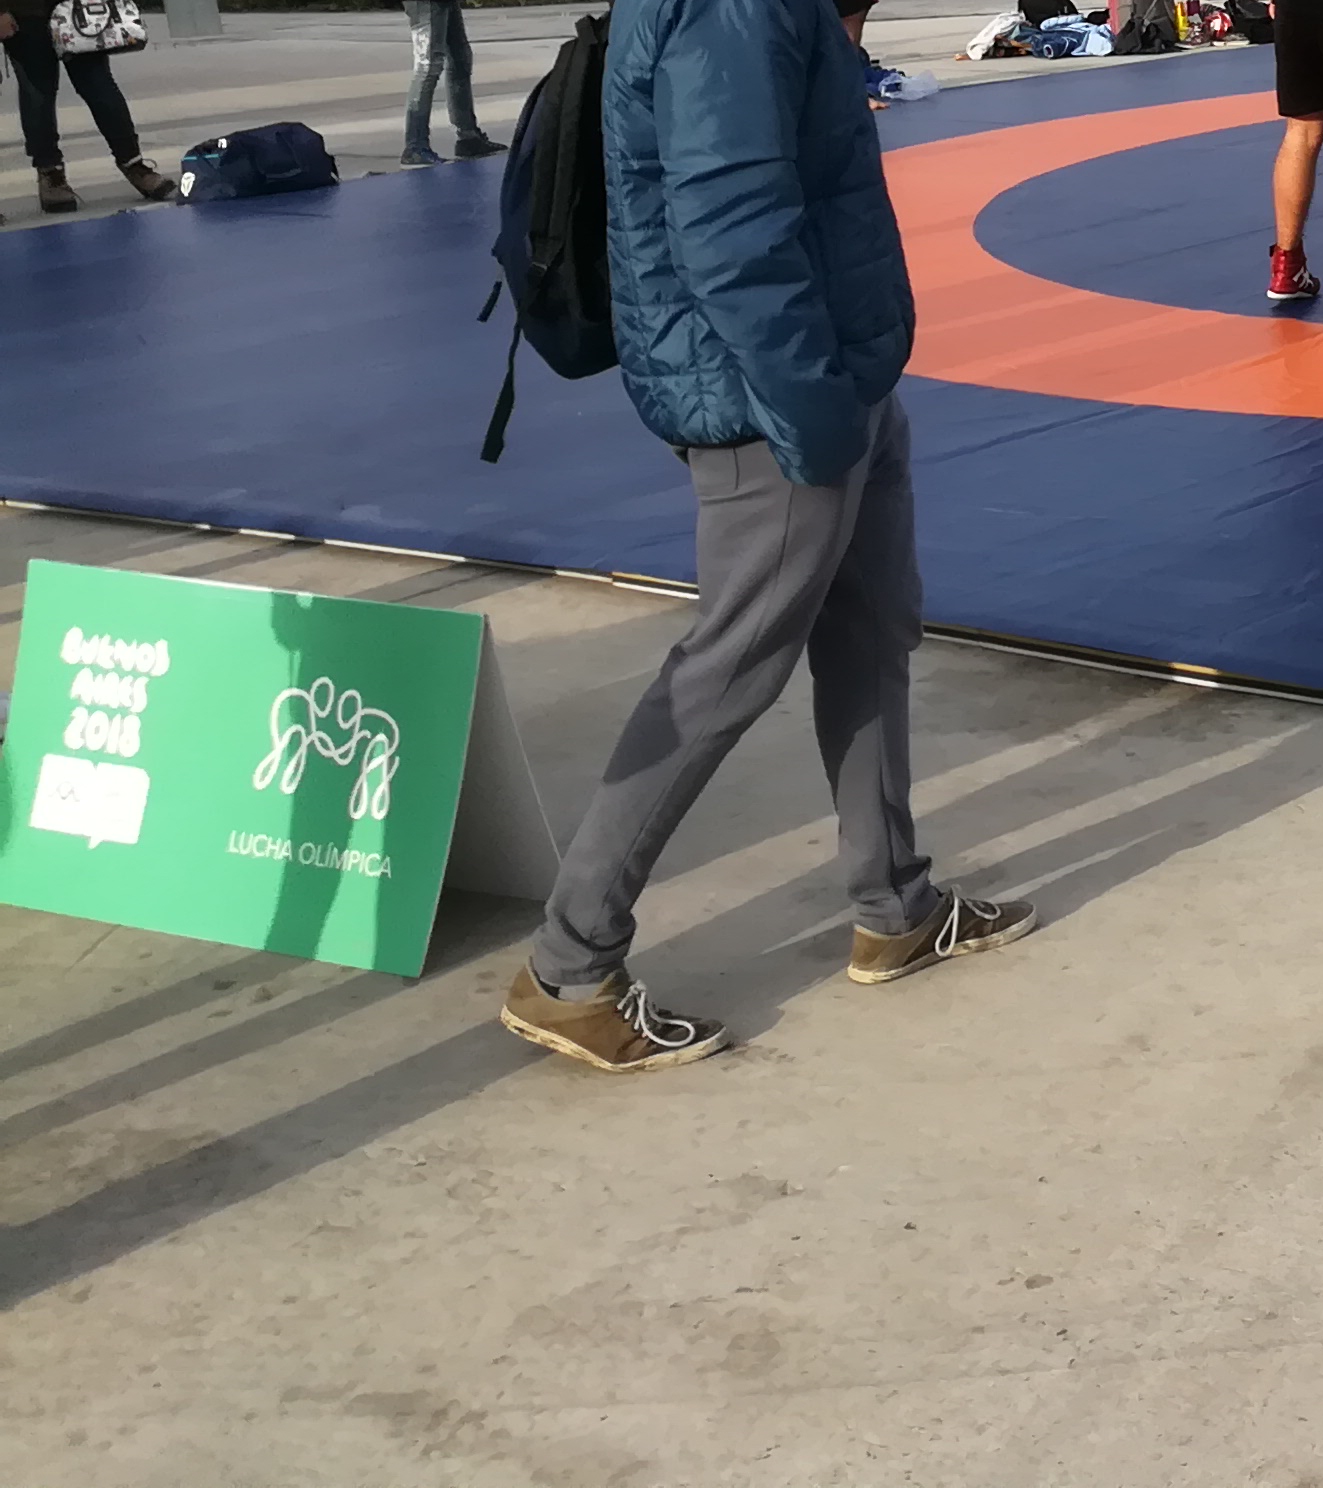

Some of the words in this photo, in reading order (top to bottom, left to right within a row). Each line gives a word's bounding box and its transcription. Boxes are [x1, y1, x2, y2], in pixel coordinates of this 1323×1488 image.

[60, 623, 171, 677] BUENOS
[70, 666, 151, 714] AIRES
[63, 705, 142, 758] 2018
[226, 829, 293, 862] LUCHA
[298, 840, 393, 880] OLÍMPICA
